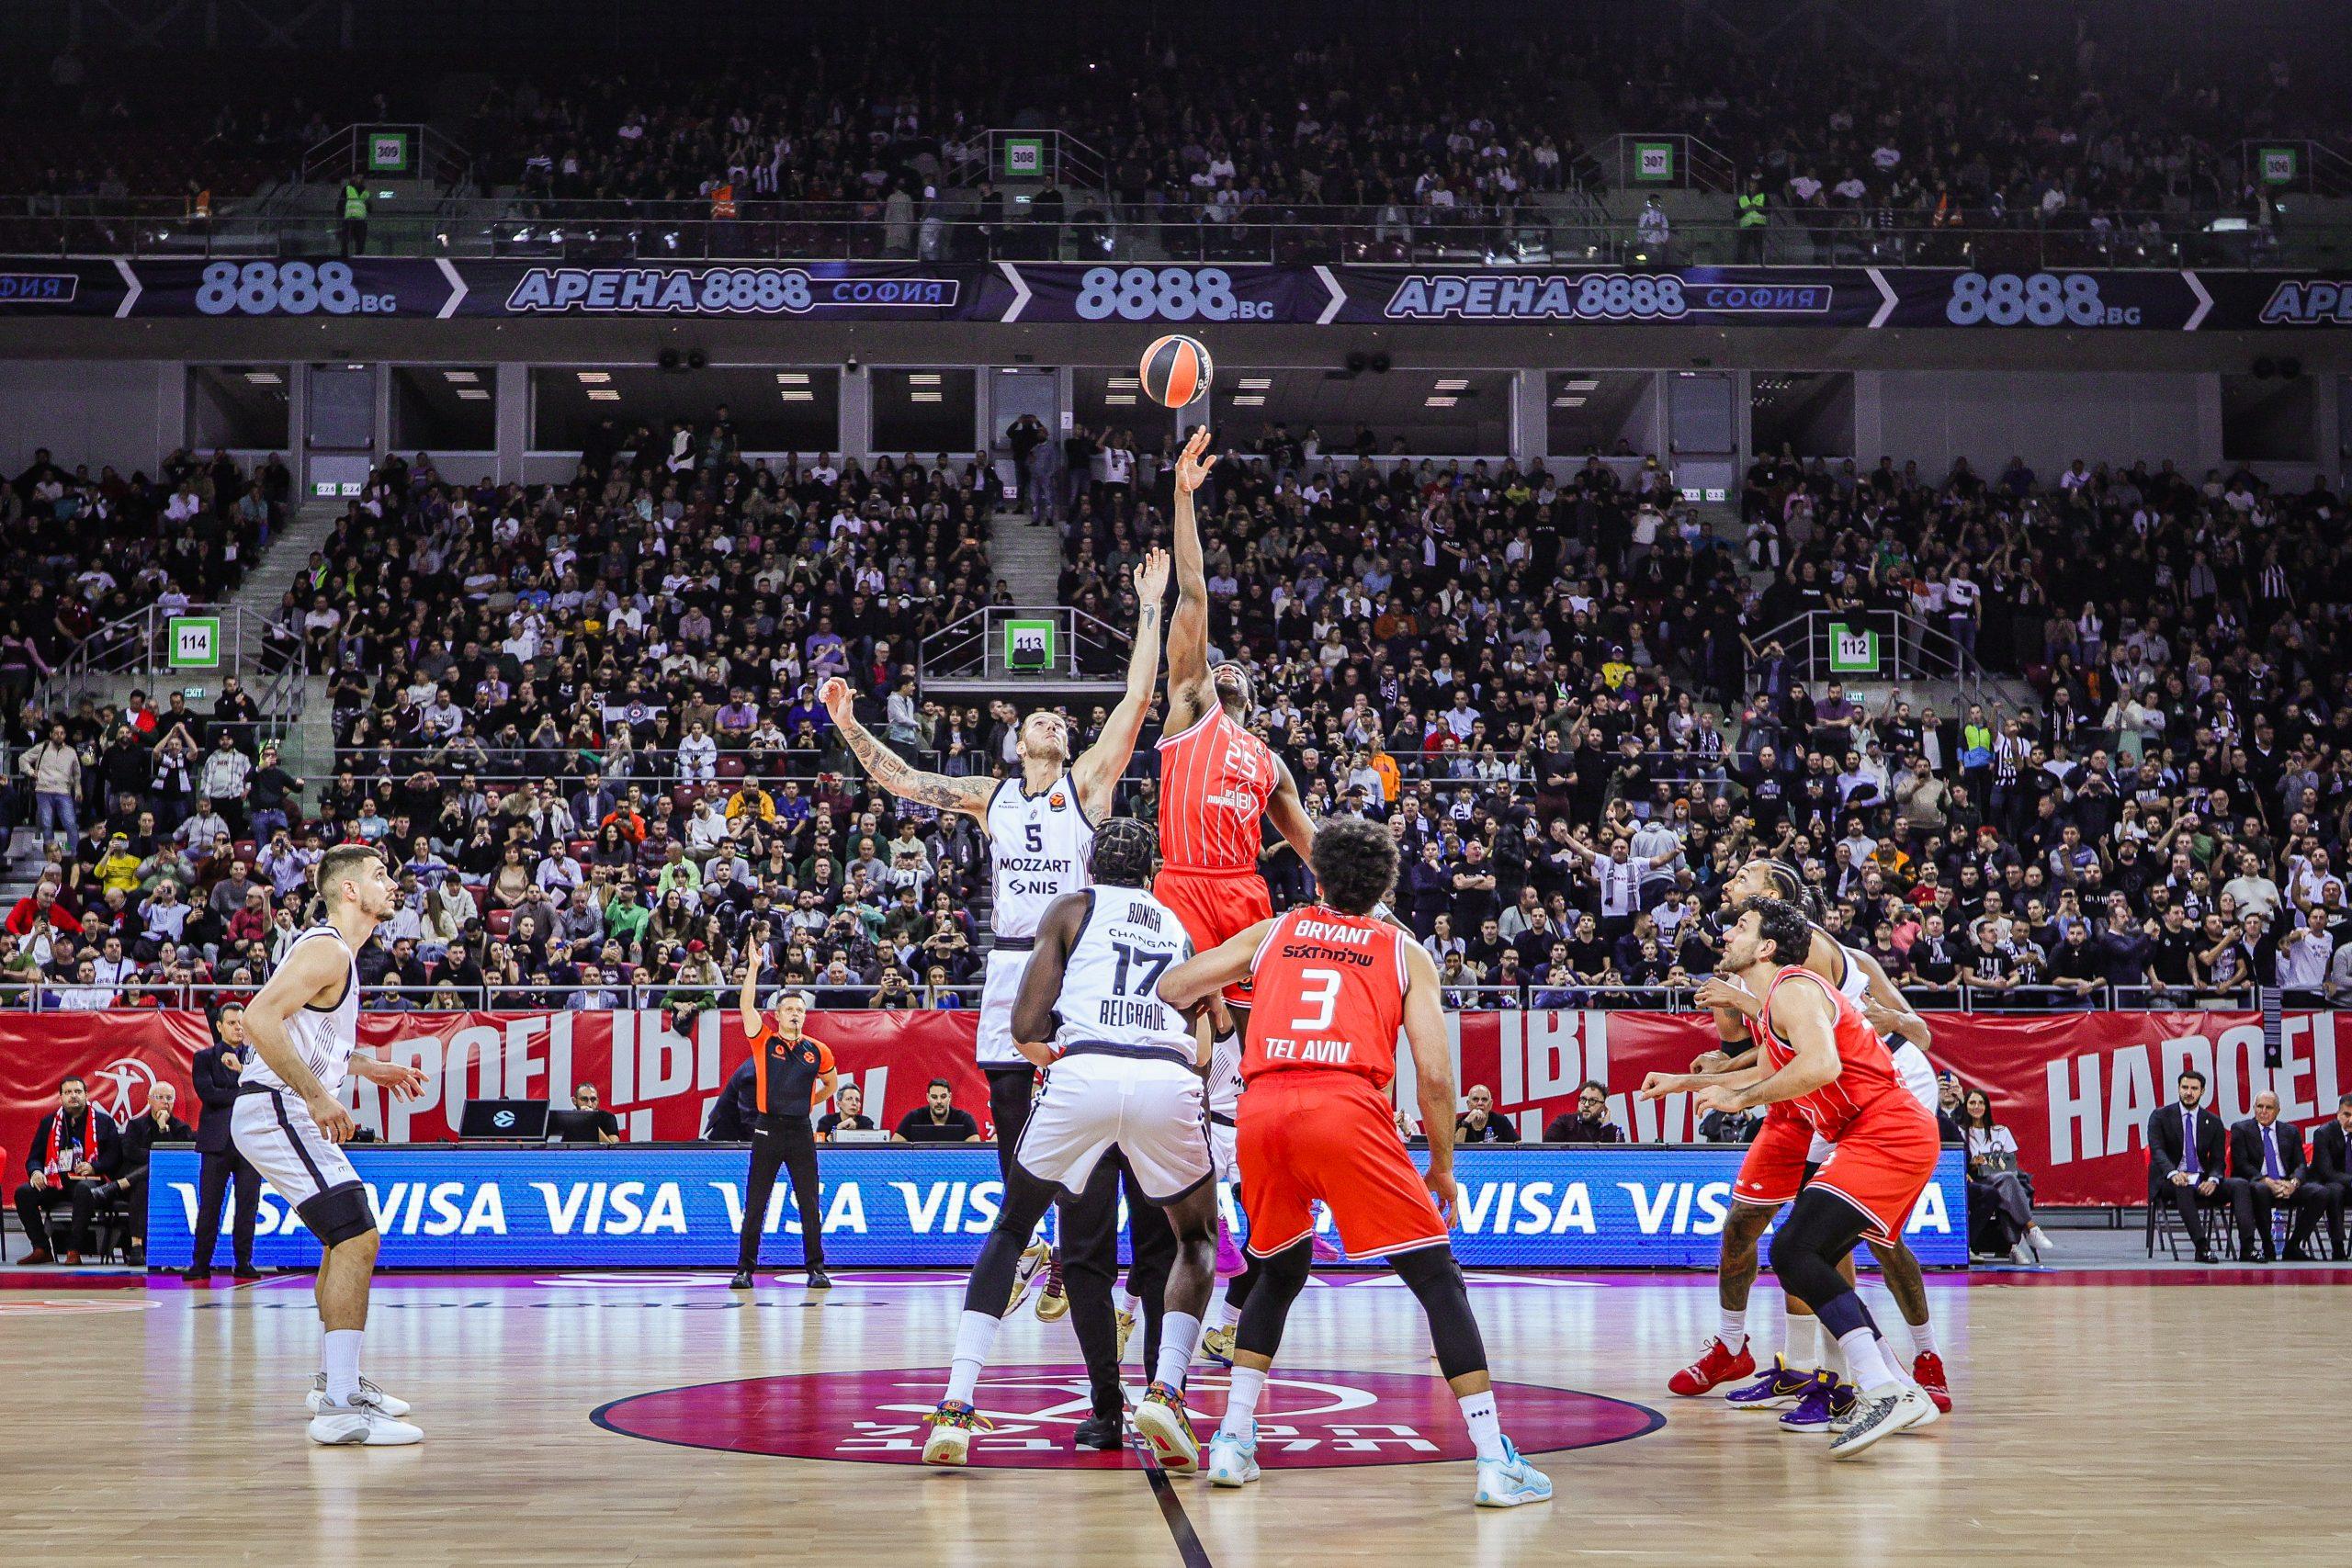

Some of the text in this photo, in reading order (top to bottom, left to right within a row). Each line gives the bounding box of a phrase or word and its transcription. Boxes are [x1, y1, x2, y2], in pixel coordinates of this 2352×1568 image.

[1013, 152, 1035, 163] 308
[1645, 156, 1664, 167] 307
[512, 272, 944, 308] АРЕНА 8888 СОФИЯ
[1391, 278, 1815, 314] АРЕНА 8888 СОФИЯ
[181, 635, 207, 650] 114
[1017, 637, 1042, 649] 113
[1841, 639, 1867, 655] 112
[185, 688, 203, 698] EXIT
[1225, 739, 1257, 782] 25
[1024, 823, 1043, 853] 5
[999, 857, 1072, 874] MOZZART
[1028, 881, 1058, 895] NIS
[1126, 902, 1161, 934] BONGA
[1294, 919, 1375, 946] BRYANT
[1108, 928, 1178, 949] CHANGAN
[1112, 942, 1173, 998] 17
[1099, 999, 1170, 1032] BELGRADE
[1290, 968, 1342, 1031] 3
[1265, 1037, 1351, 1064] TEL AVIV
[1499, 1010, 1609, 1107] IBI
[336, 1010, 573, 1142] APOEL
[612, 1010, 720, 1106] IBI
[2047, 1010, 2342, 1167] HAPOEL
[529, 1181, 688, 1235] VISA
[888, 1181, 1046, 1234] VIS
[1617, 1181, 1774, 1235] VIS
